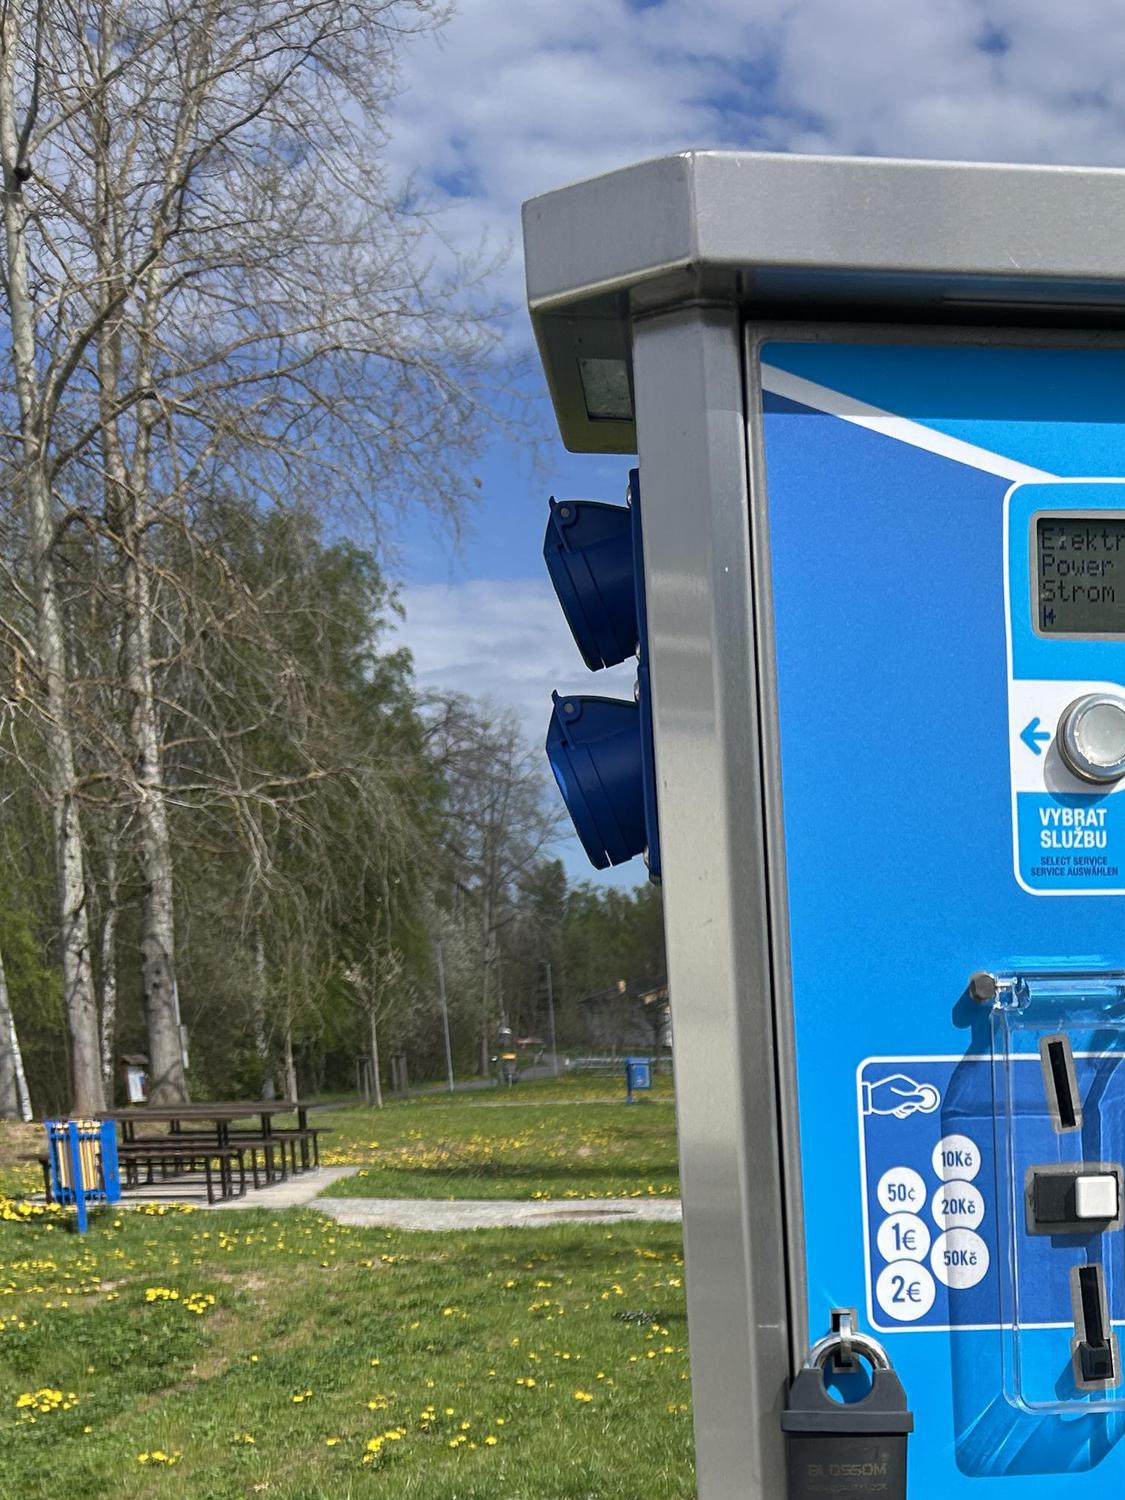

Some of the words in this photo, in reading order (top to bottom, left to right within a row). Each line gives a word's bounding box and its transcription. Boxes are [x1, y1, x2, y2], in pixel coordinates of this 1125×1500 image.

[1041, 554, 1114, 577] Power
[1041, 580, 1115, 603] Strom
[1039, 808, 1107, 826] VYBRAT
[1040, 826, 1107, 848] SLUŽBU
[1040, 856, 1071, 866] SELECT
[1073, 856, 1108, 866] SERVICE
[1031, 867, 1065, 877] SERVICE
[941, 1151, 972, 1167] 10Kč
[941, 1199, 975, 1215] 20Kč
[891, 1223, 917, 1251] 1€
[943, 1251, 977, 1266] 50Kč
[891, 1275, 922, 1302] 2€
[808, 1463, 887, 1476] BOSSOM
